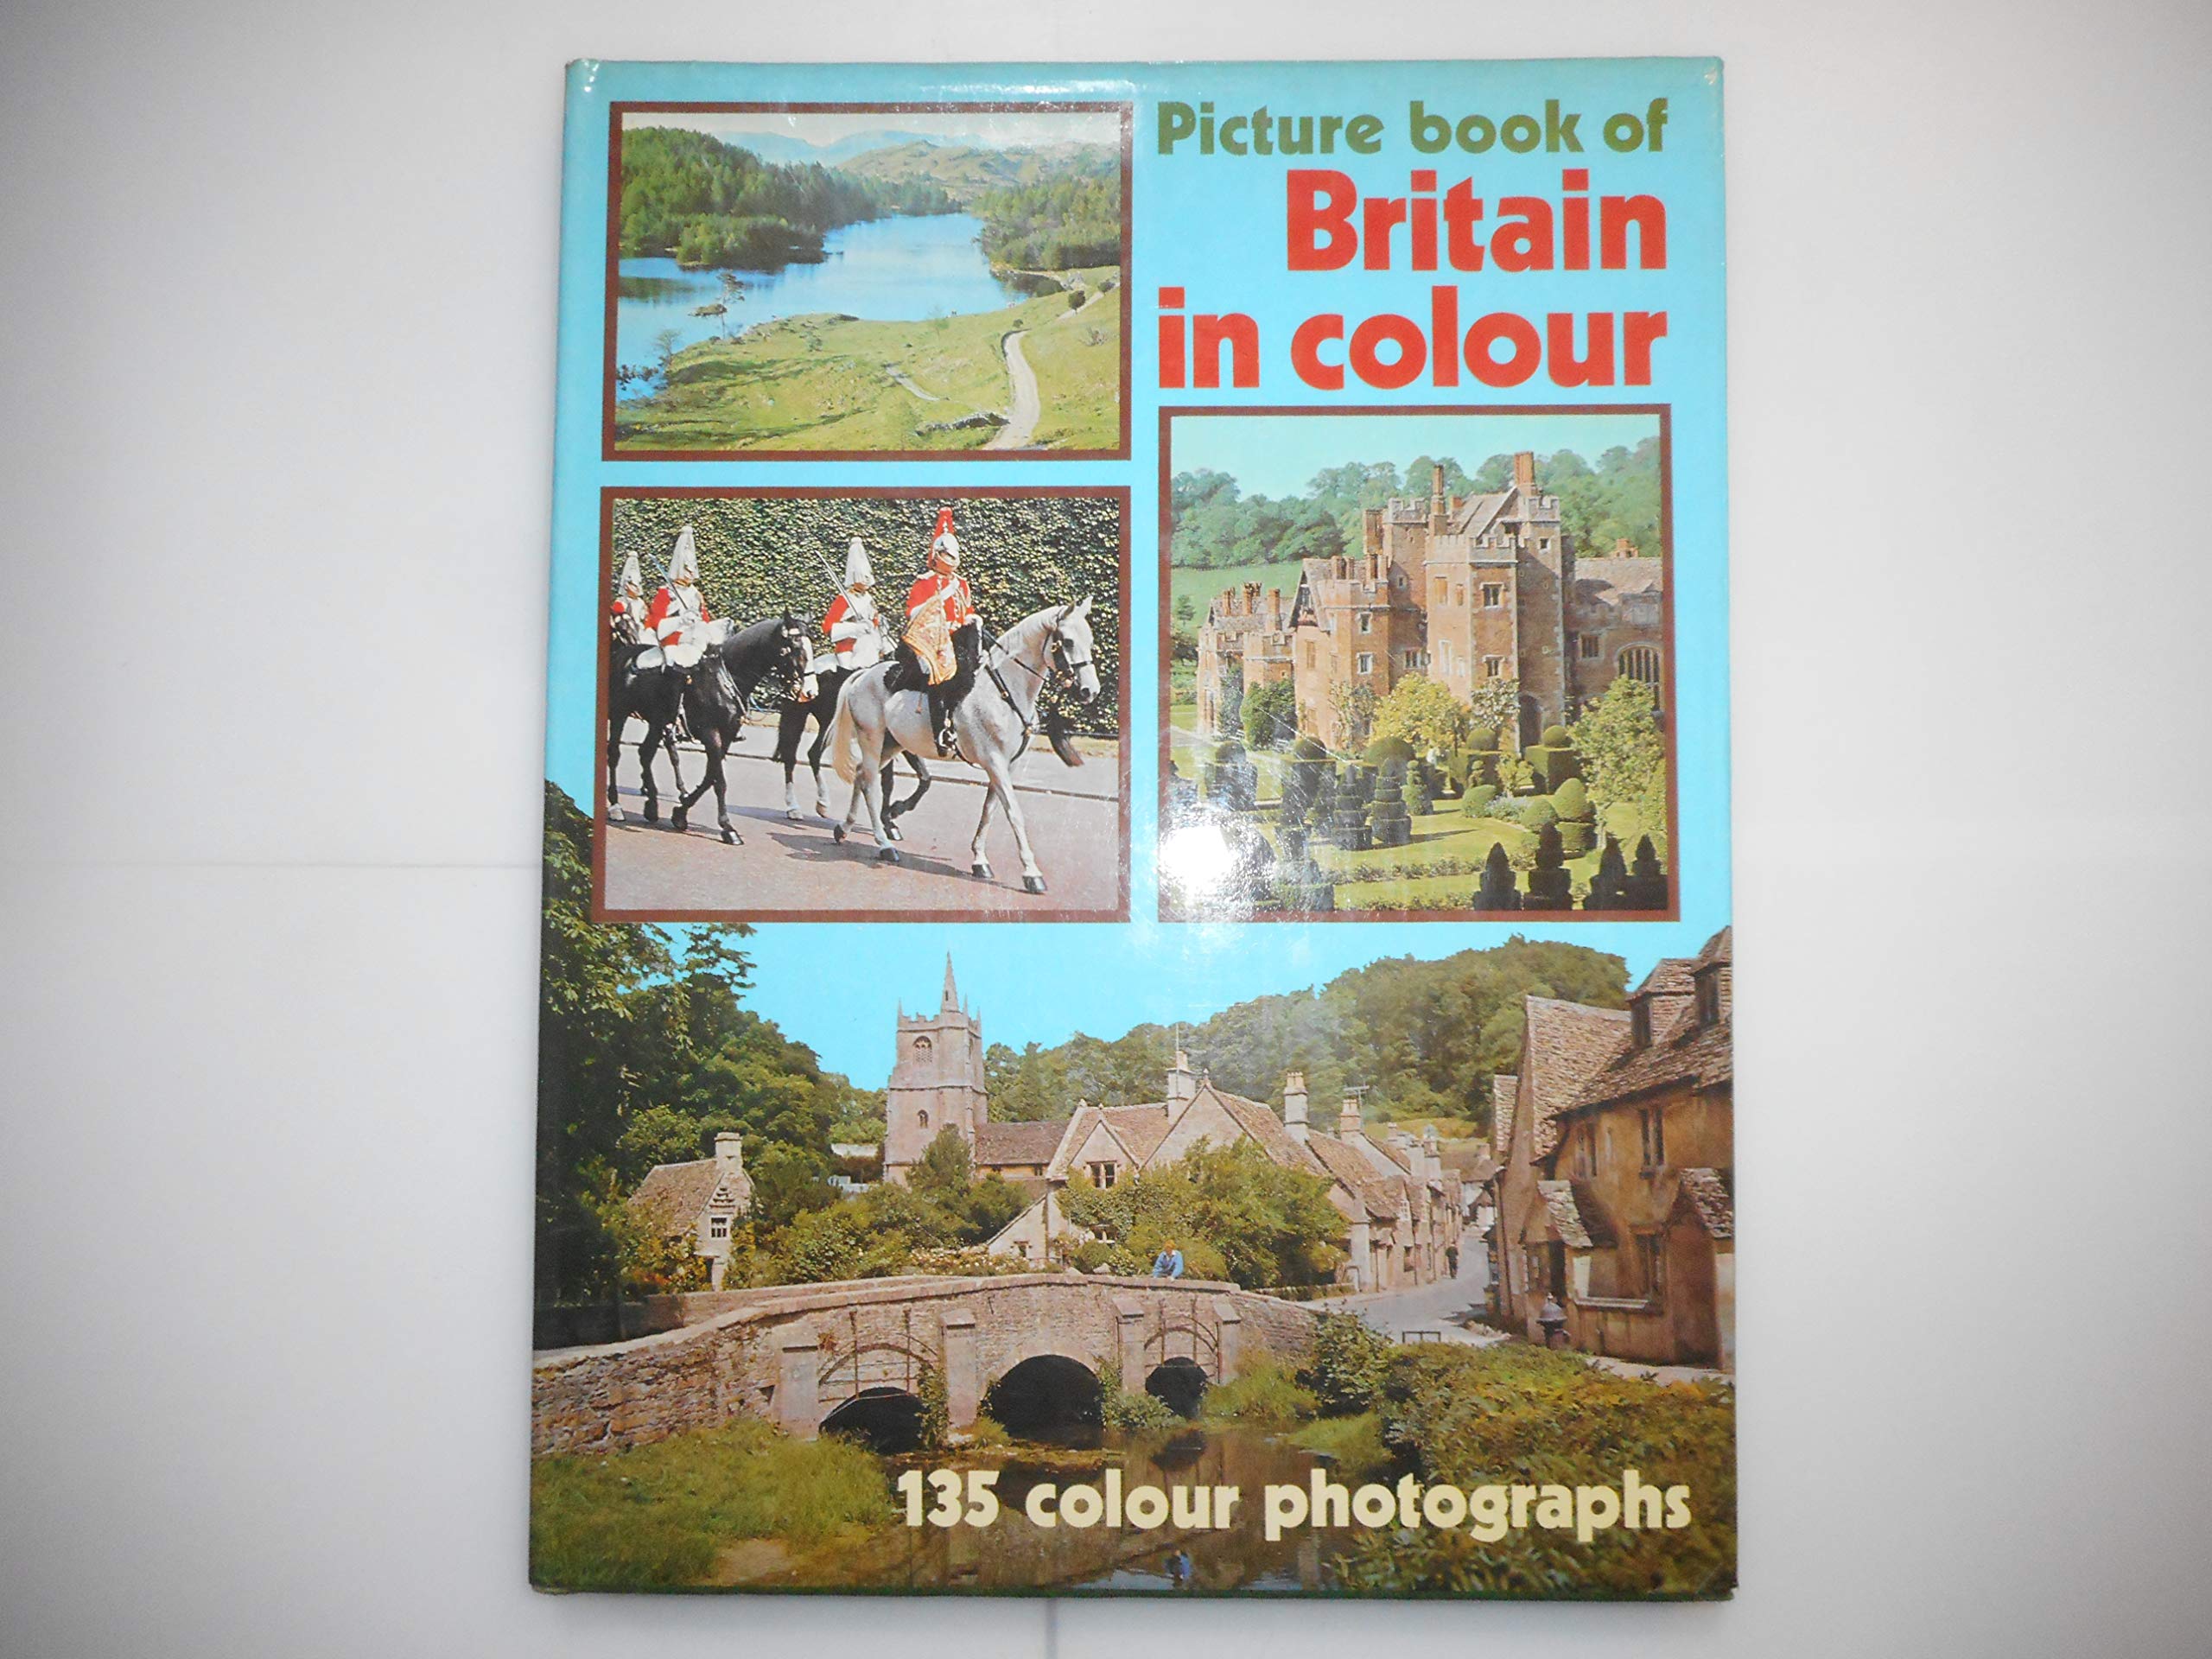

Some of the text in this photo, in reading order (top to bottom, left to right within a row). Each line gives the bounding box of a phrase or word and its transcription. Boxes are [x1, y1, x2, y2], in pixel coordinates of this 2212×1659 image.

[1158, 98, 1669, 156] Picture book of
[1287, 168, 1667, 272] Britain
[1158, 285, 1668, 391] in colour
[897, 1467, 1692, 1543] 135 colour photographs
